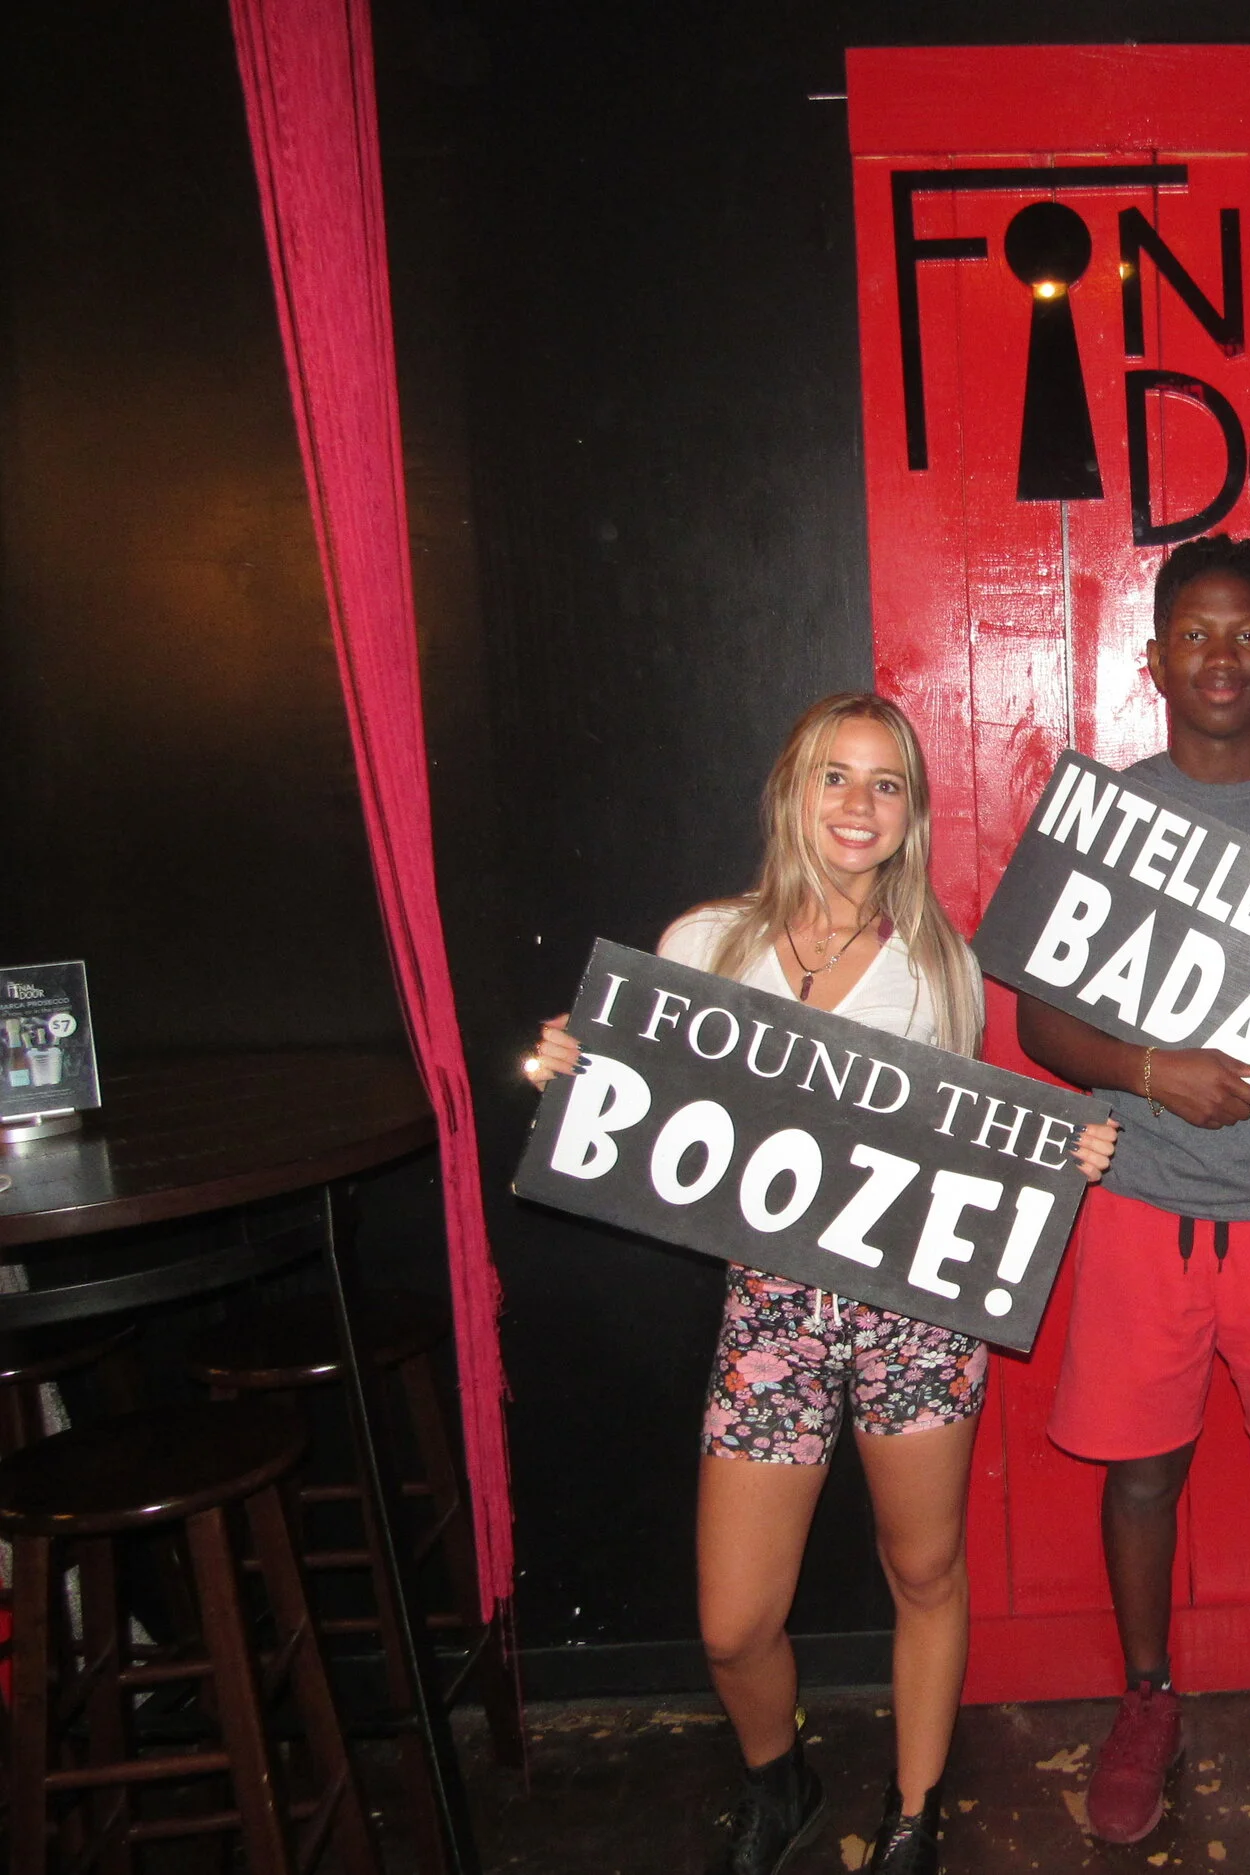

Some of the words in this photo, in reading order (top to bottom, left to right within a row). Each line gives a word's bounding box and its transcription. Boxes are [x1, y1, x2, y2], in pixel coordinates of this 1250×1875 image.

[19, 990, 45, 1000] DOOR
[592, 973, 628, 1026] I
[638, 988, 911, 1114] FOUND
[934, 1081, 1076, 1171] THE
[551, 1053, 1055, 1316] BOOZE!
